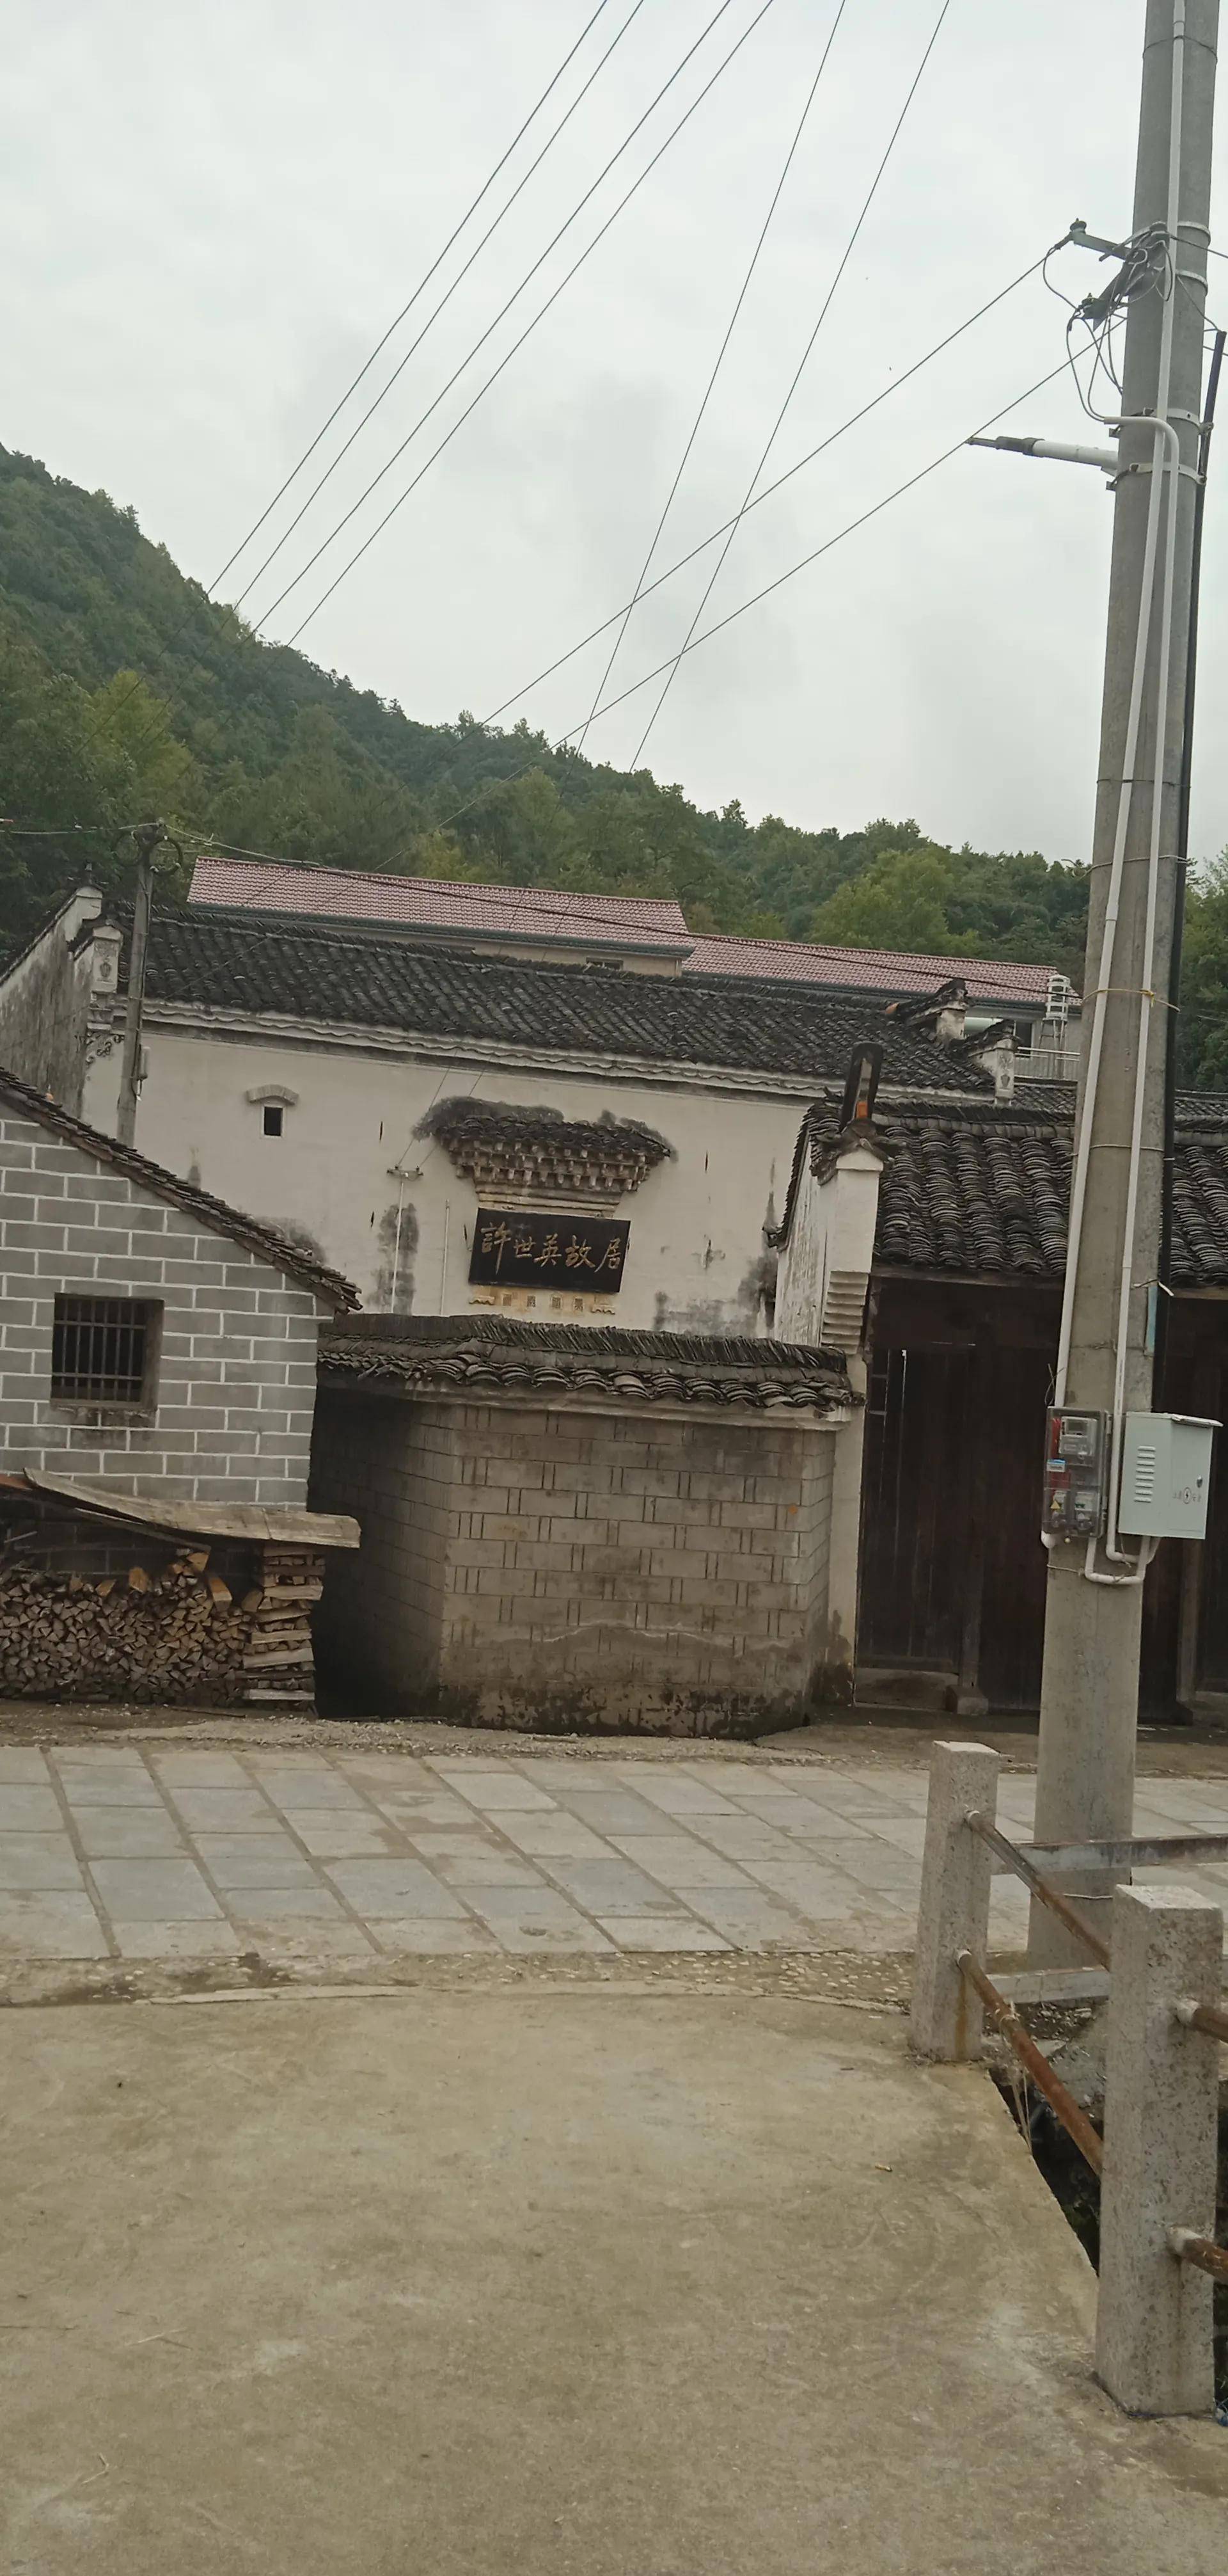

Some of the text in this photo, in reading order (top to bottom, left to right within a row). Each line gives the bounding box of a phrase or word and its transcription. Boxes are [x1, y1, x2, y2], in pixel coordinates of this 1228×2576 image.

[481, 1221, 622, 1275] 許世英故居
